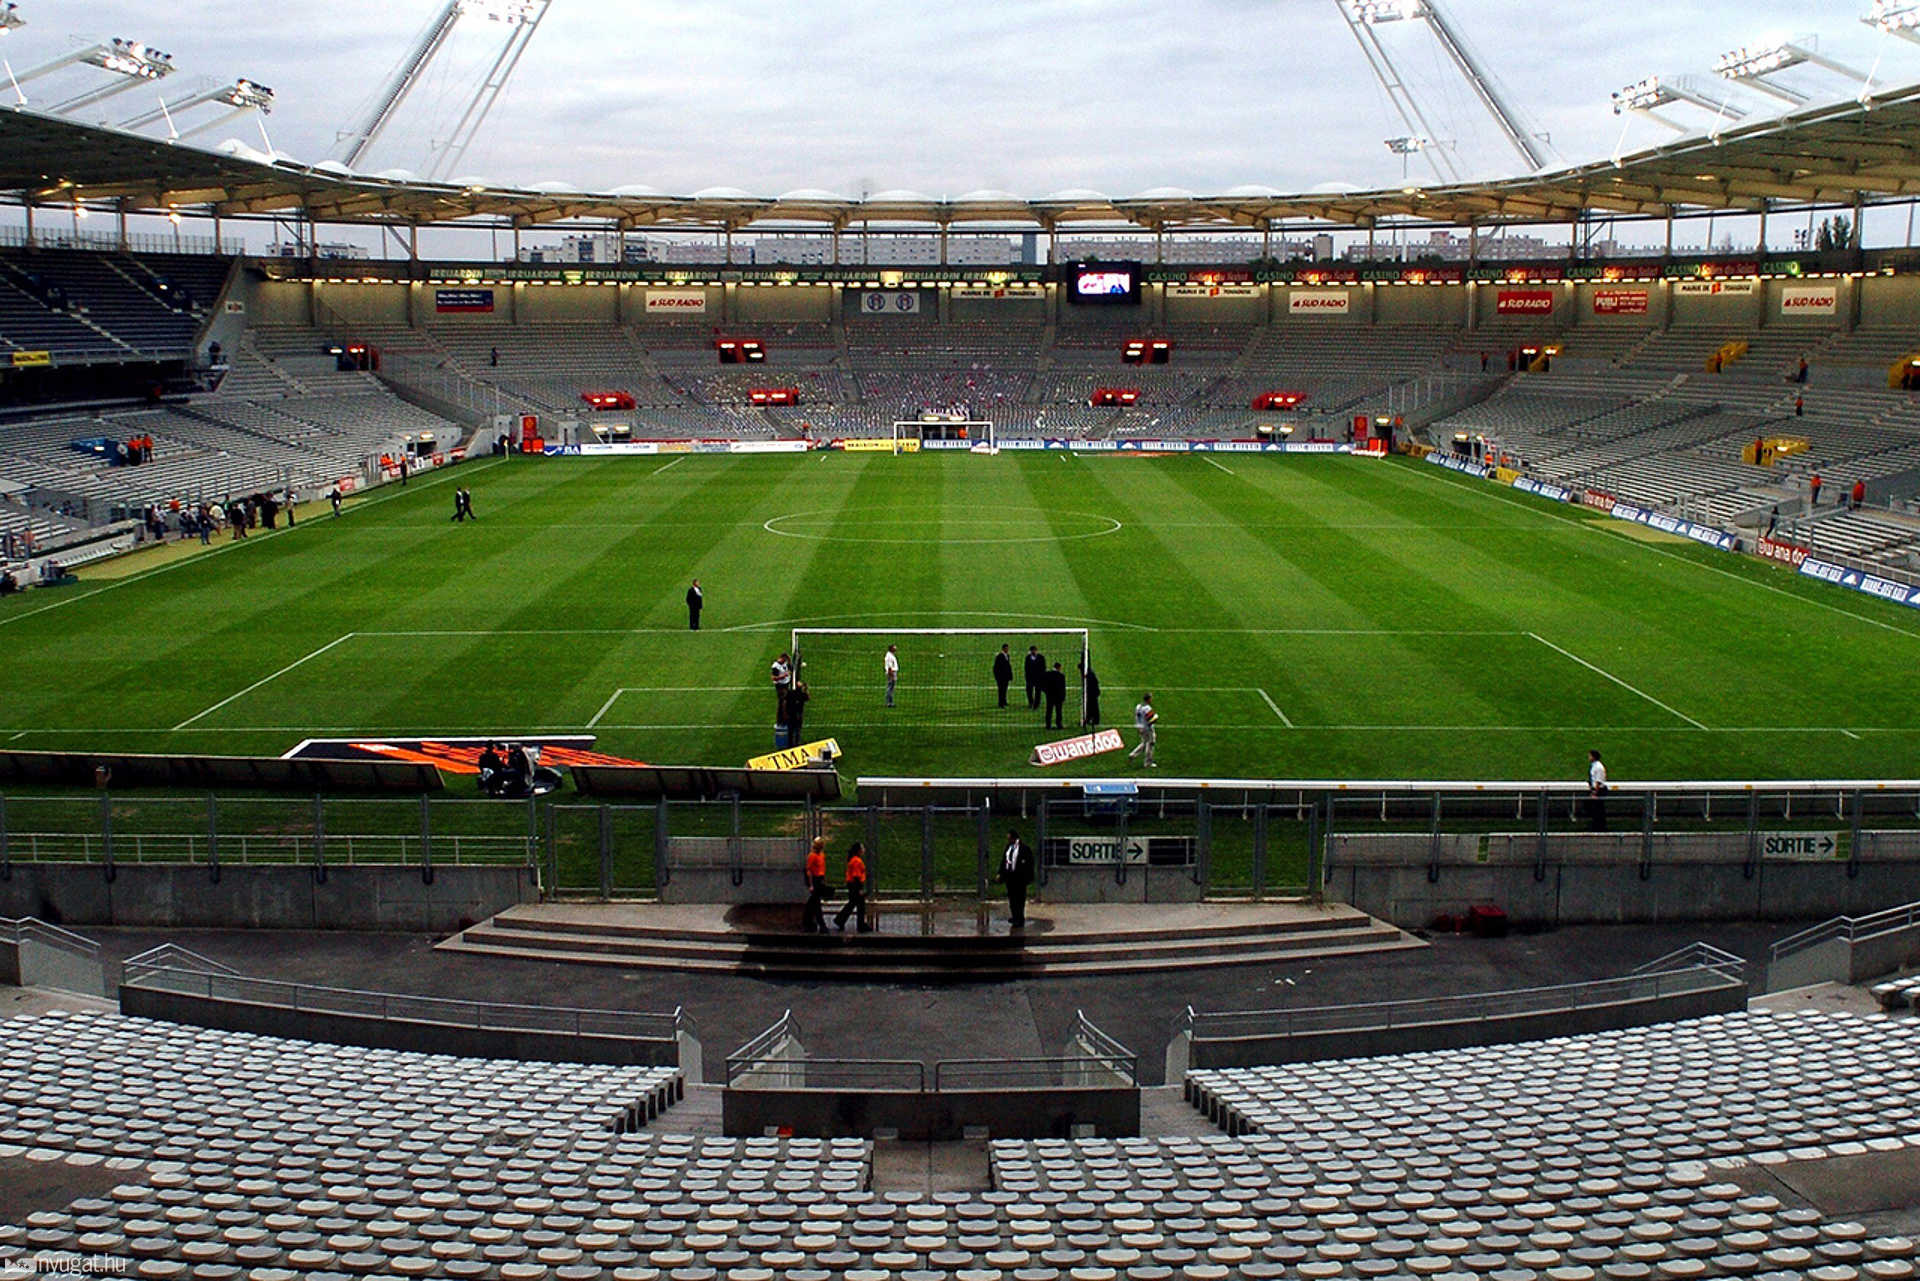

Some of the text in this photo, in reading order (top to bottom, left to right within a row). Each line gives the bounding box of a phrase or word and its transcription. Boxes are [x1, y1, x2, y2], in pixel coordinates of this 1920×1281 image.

[1568, 266, 1601, 278] CASINO
[1665, 264, 1700, 275] CASINO
[1763, 261, 1798, 274] CASINO
[1149, 272, 1187, 281] CASINO
[1256, 271, 1294, 281] CASINO
[1363, 271, 1399, 280] CASINO
[1466, 268, 1503, 279] CASINO
[658, 298, 703, 307] SUD RADIO
[1301, 299, 1346, 308] SUD RADIO
[1507, 299, 1550, 308] SUD RADIO
[1792, 297, 1834, 307] SUD RADIO
[1040, 734, 1121, 763] @wanadoo
[1766, 837, 1816, 853] SORTIE
